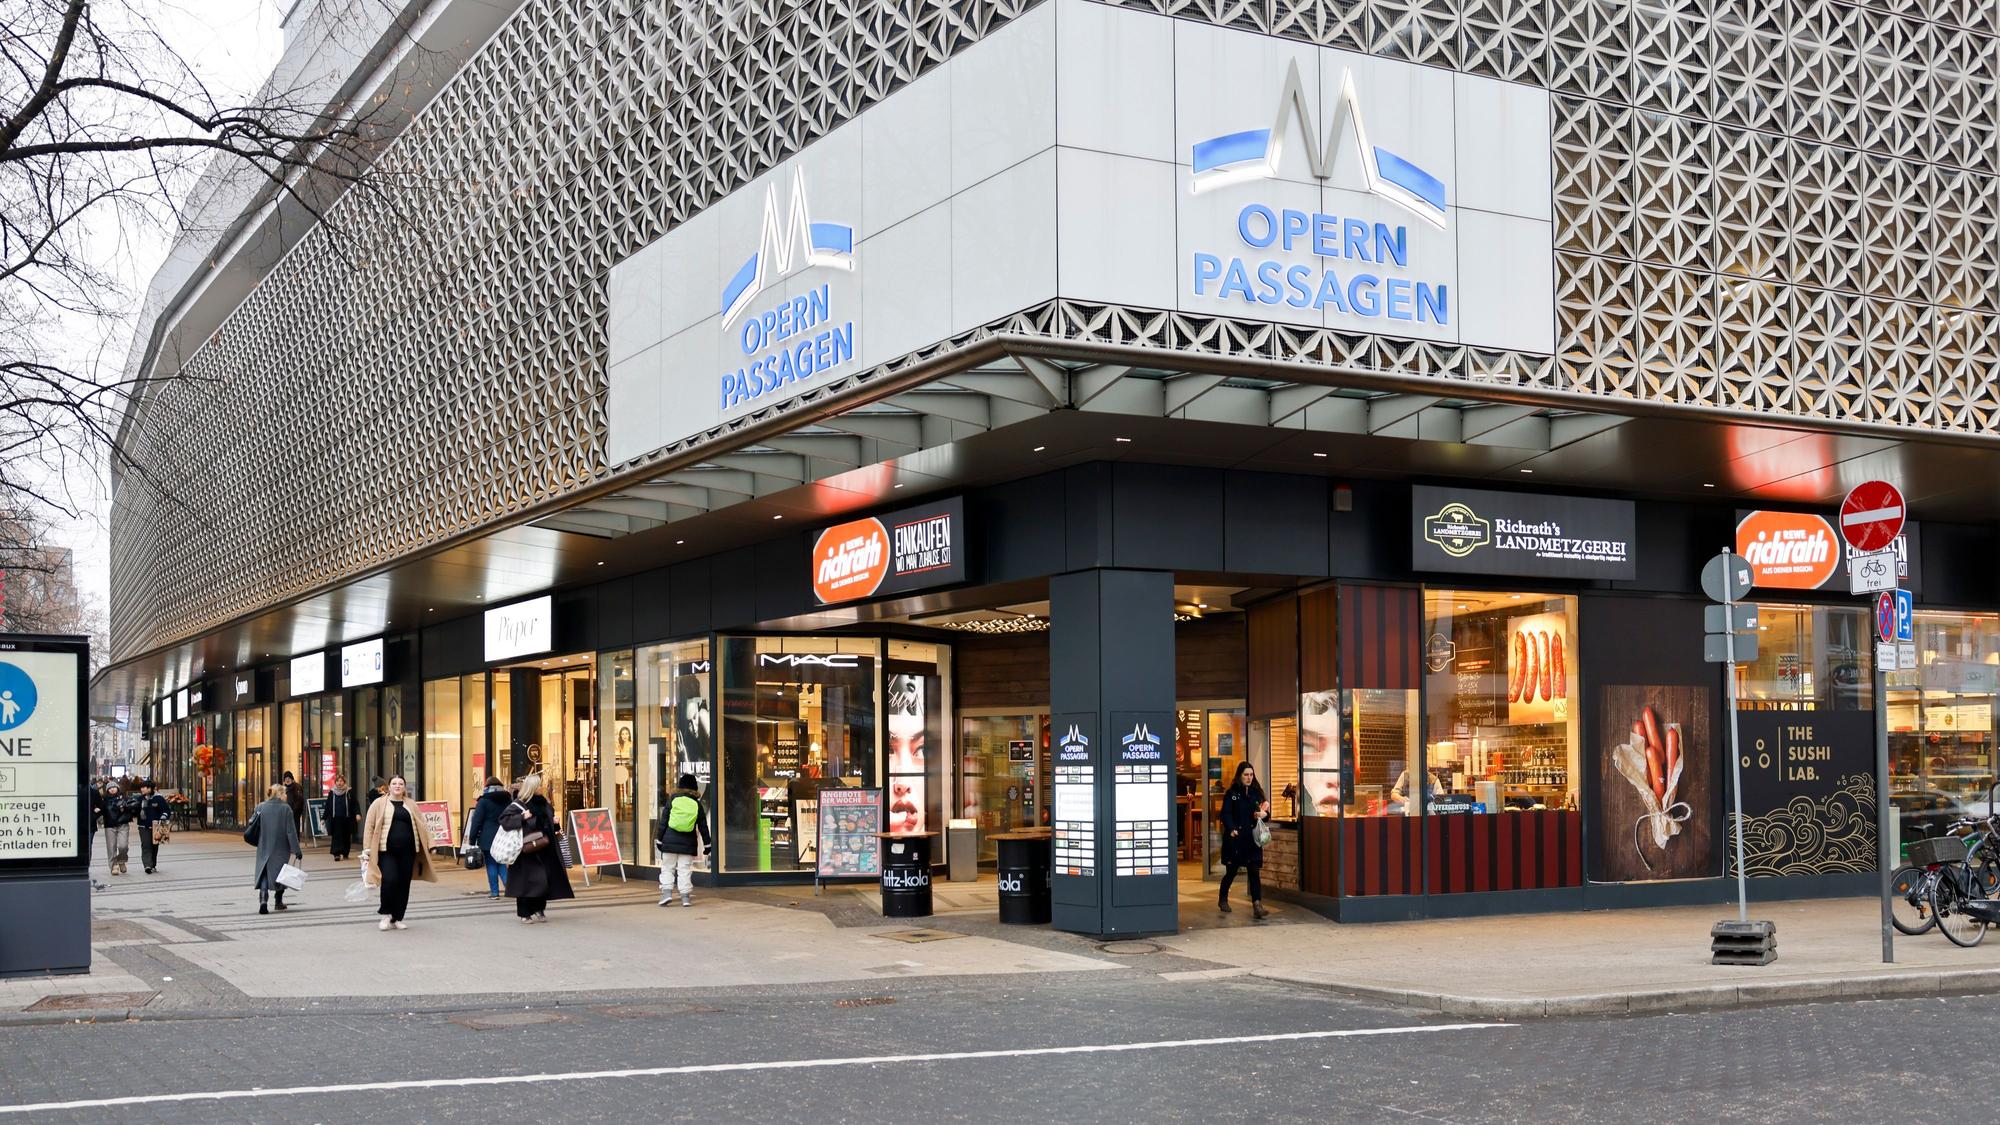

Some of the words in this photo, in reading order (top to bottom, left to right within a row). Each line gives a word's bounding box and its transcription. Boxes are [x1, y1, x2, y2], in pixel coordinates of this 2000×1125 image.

[1237, 203, 1408, 267] OPERN
[1193, 252, 1448, 325] PASSAGEN
[740, 283, 829, 355] OPERN
[720, 322, 853, 410] PASSAGEN
[1495, 519, 1560, 536] Richrath's
[1783, 529, 1806, 539] REWE
[895, 516, 950, 557] EINKAUFEN
[1496, 535, 1626, 555] LANDMETZGEREI
[1745, 529, 1828, 565] richrath
[818, 531, 881, 585] richrath
[1867, 578, 1882, 587] frei
[1898, 596, 1907, 633] P
[1788, 726, 1813, 741] THE
[1064, 745, 1084, 753] OPERN
[1128, 744, 1155, 752] OPERN
[1788, 746, 1831, 761] SUSHI
[1060, 752, 1089, 760] PASSAGEN
[1122, 752, 1160, 760] PASSAGEN
[1788, 768, 1820, 781] LAB.
[13, 814, 20, 823] 6
[23, 814, 31, 823] h
[424, 813, 440, 822] Sale
[16, 826, 23, 836] 6
[26, 826, 34, 836] h
[52, 839, 72, 848] frei
[883, 869, 929, 888] fritz-kola
